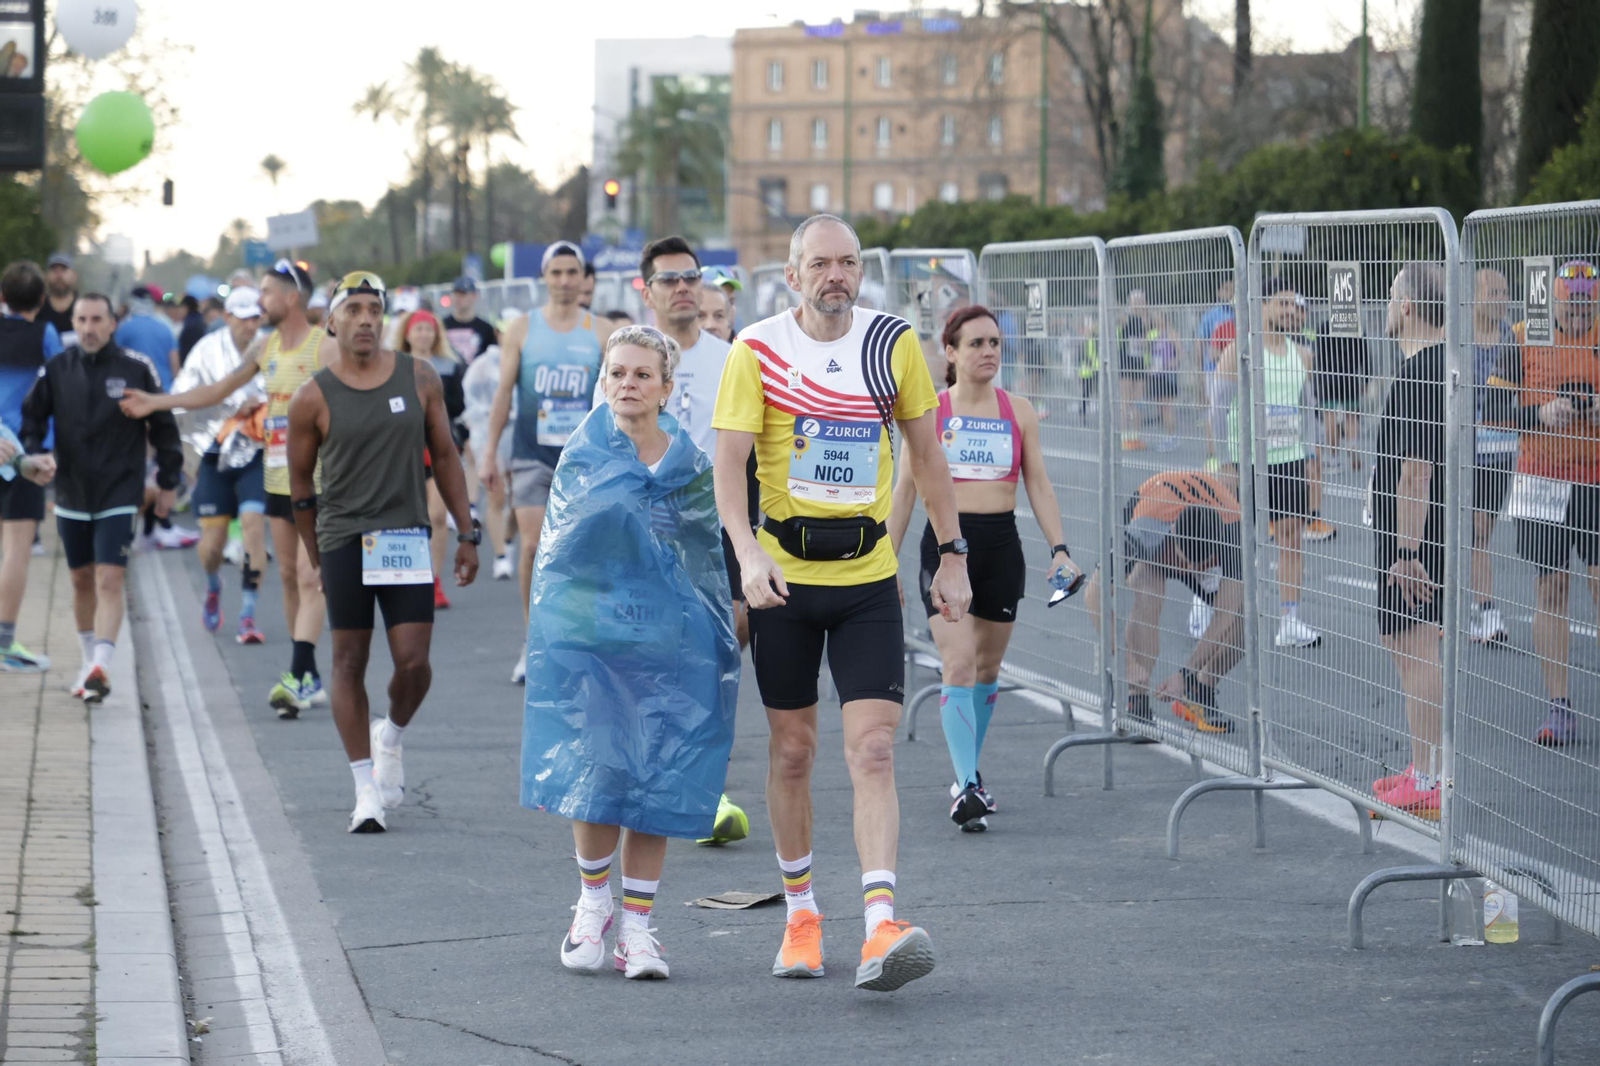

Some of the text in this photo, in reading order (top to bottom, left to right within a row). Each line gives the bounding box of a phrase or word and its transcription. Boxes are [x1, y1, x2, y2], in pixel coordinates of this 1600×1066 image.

[1333, 272, 1353, 302] AMS
[1529, 270, 1547, 305] AMS
[826, 366, 843, 374] PEAK
[825, 425, 871, 438] ZURICH
[966, 420, 1004, 431] ZURICH
[967, 438, 988, 447] 7737
[823, 450, 850, 461] 5944
[959, 449, 994, 464] SARA
[814, 464, 854, 483] NICO
[382, 555, 412, 568] BETO
